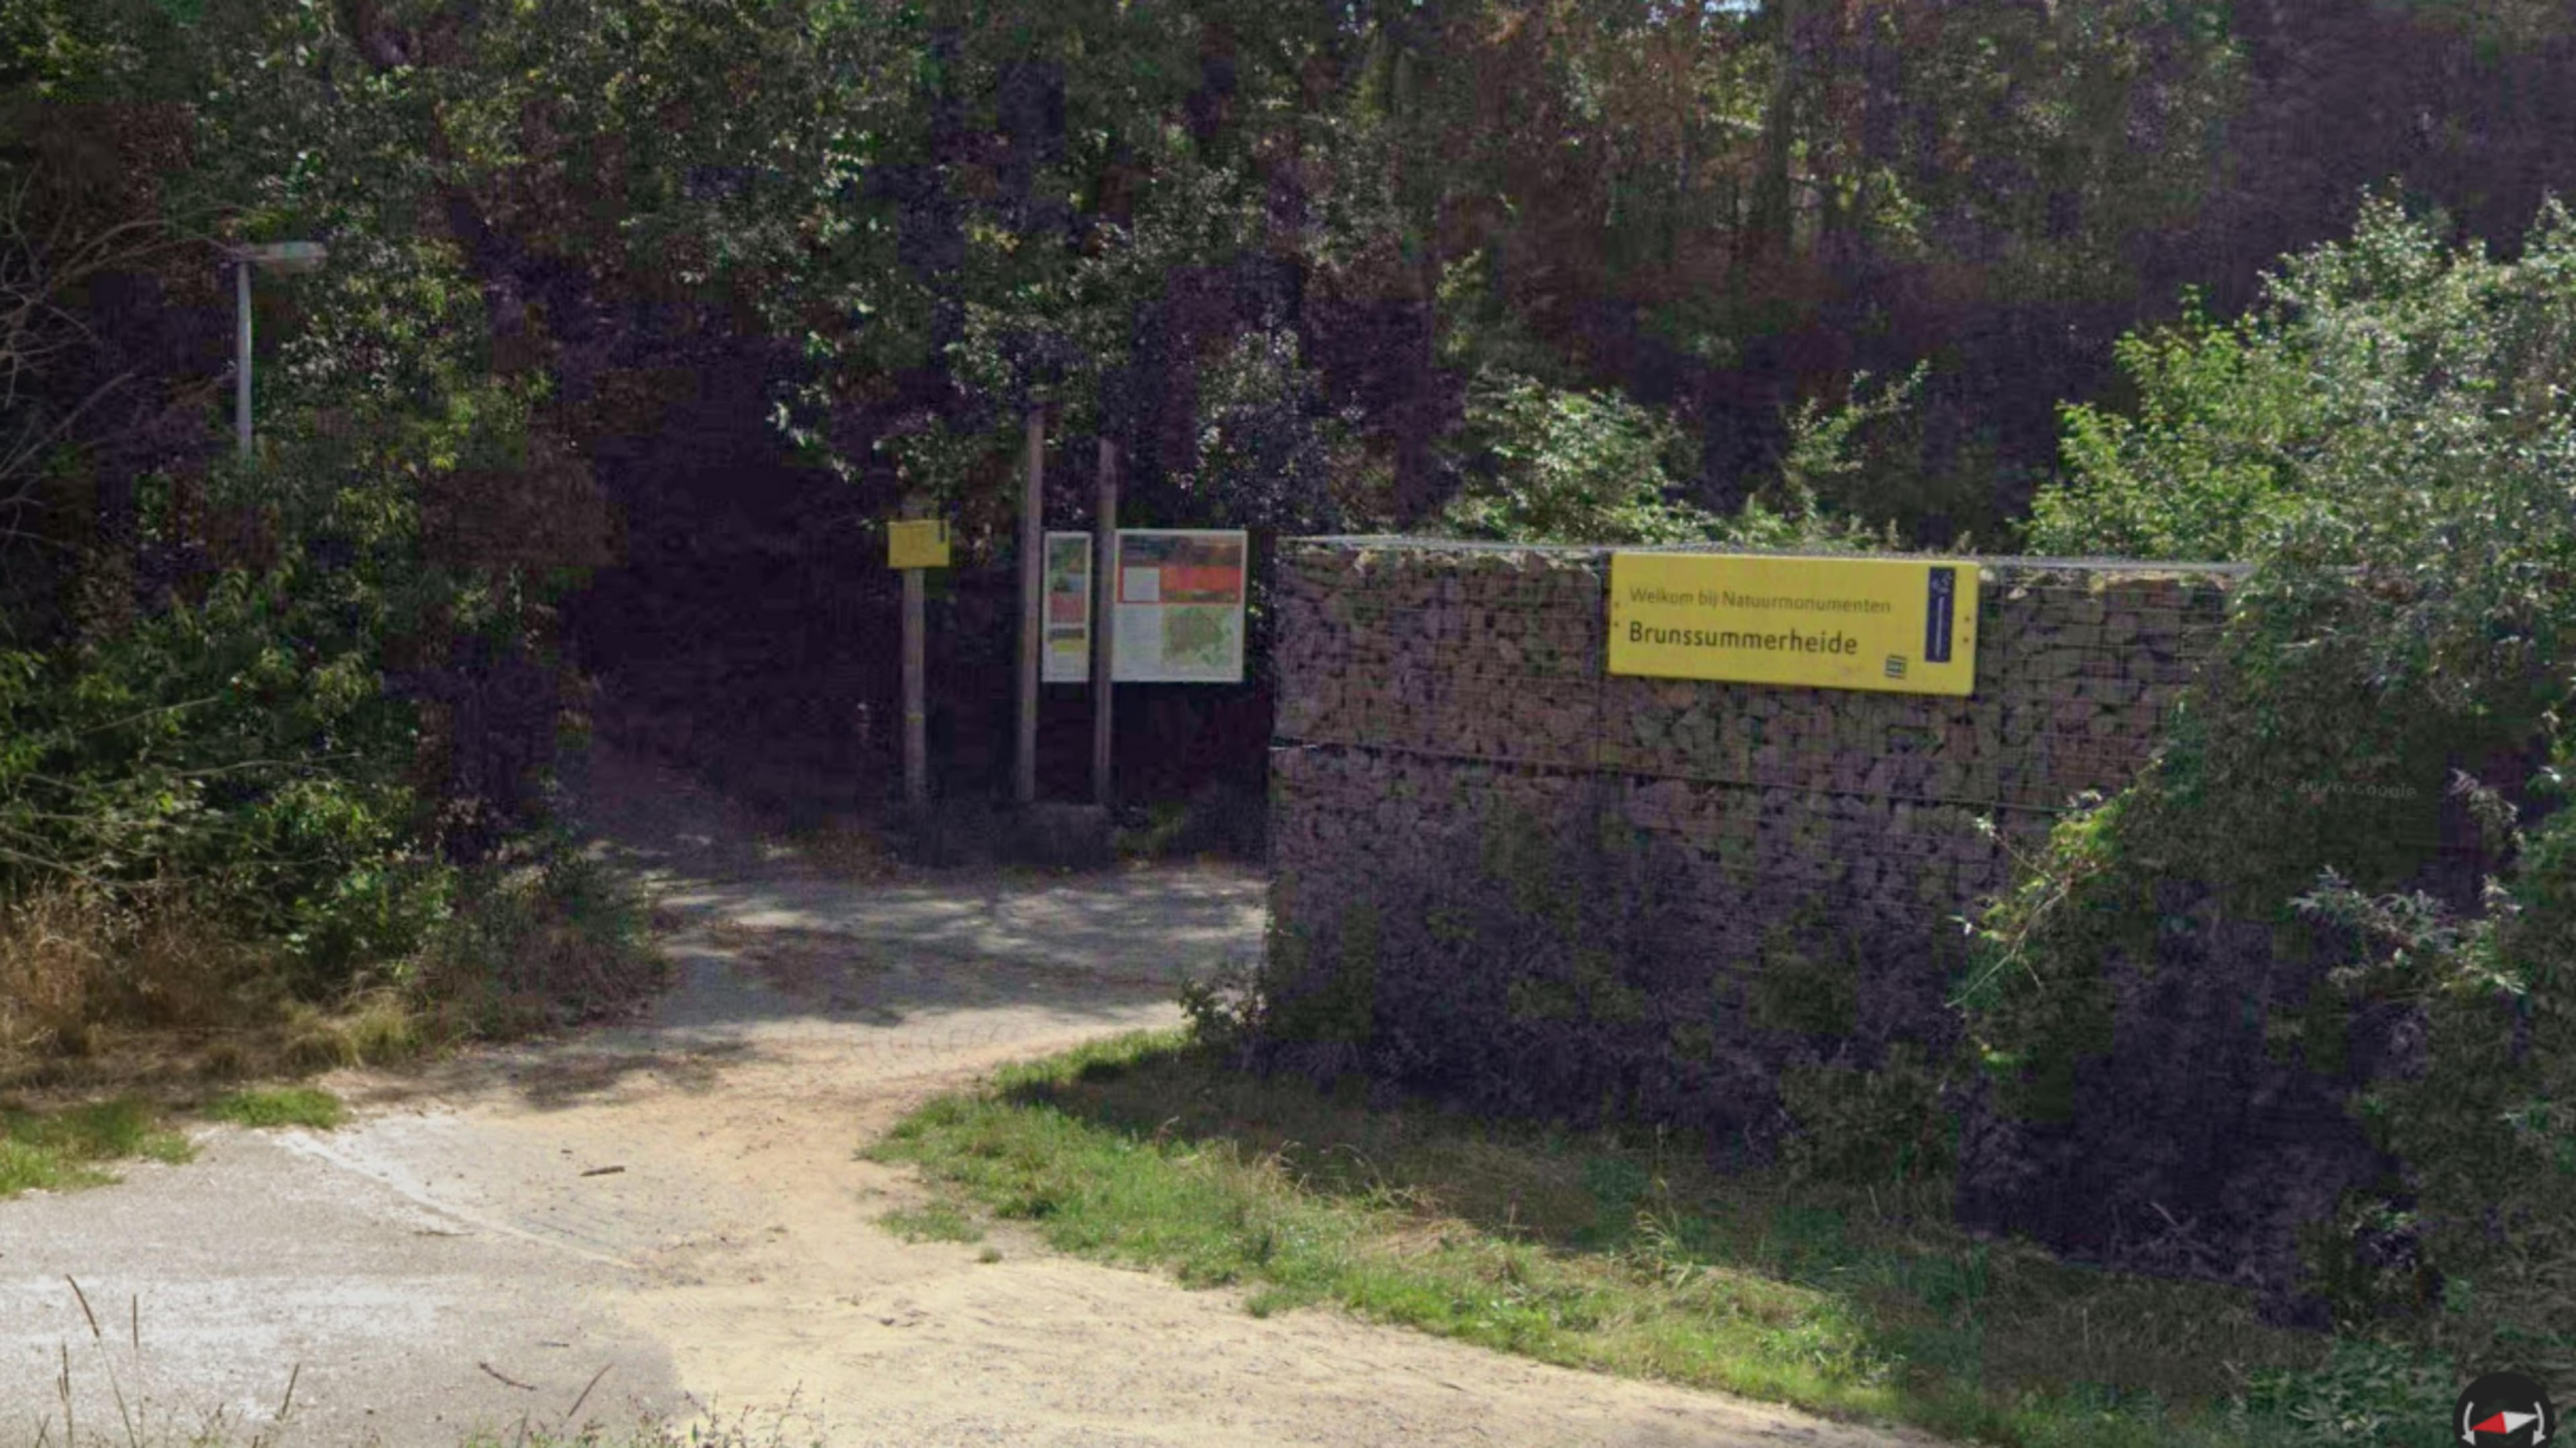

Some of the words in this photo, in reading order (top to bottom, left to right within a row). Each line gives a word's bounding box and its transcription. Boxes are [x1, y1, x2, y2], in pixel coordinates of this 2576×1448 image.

[1629, 588, 1694, 604] Welkom
[1699, 590, 1718, 608] bij
[1723, 591, 1891, 614] Natuurmonumenten
[1629, 621, 1858, 655] Brunssummerheide
